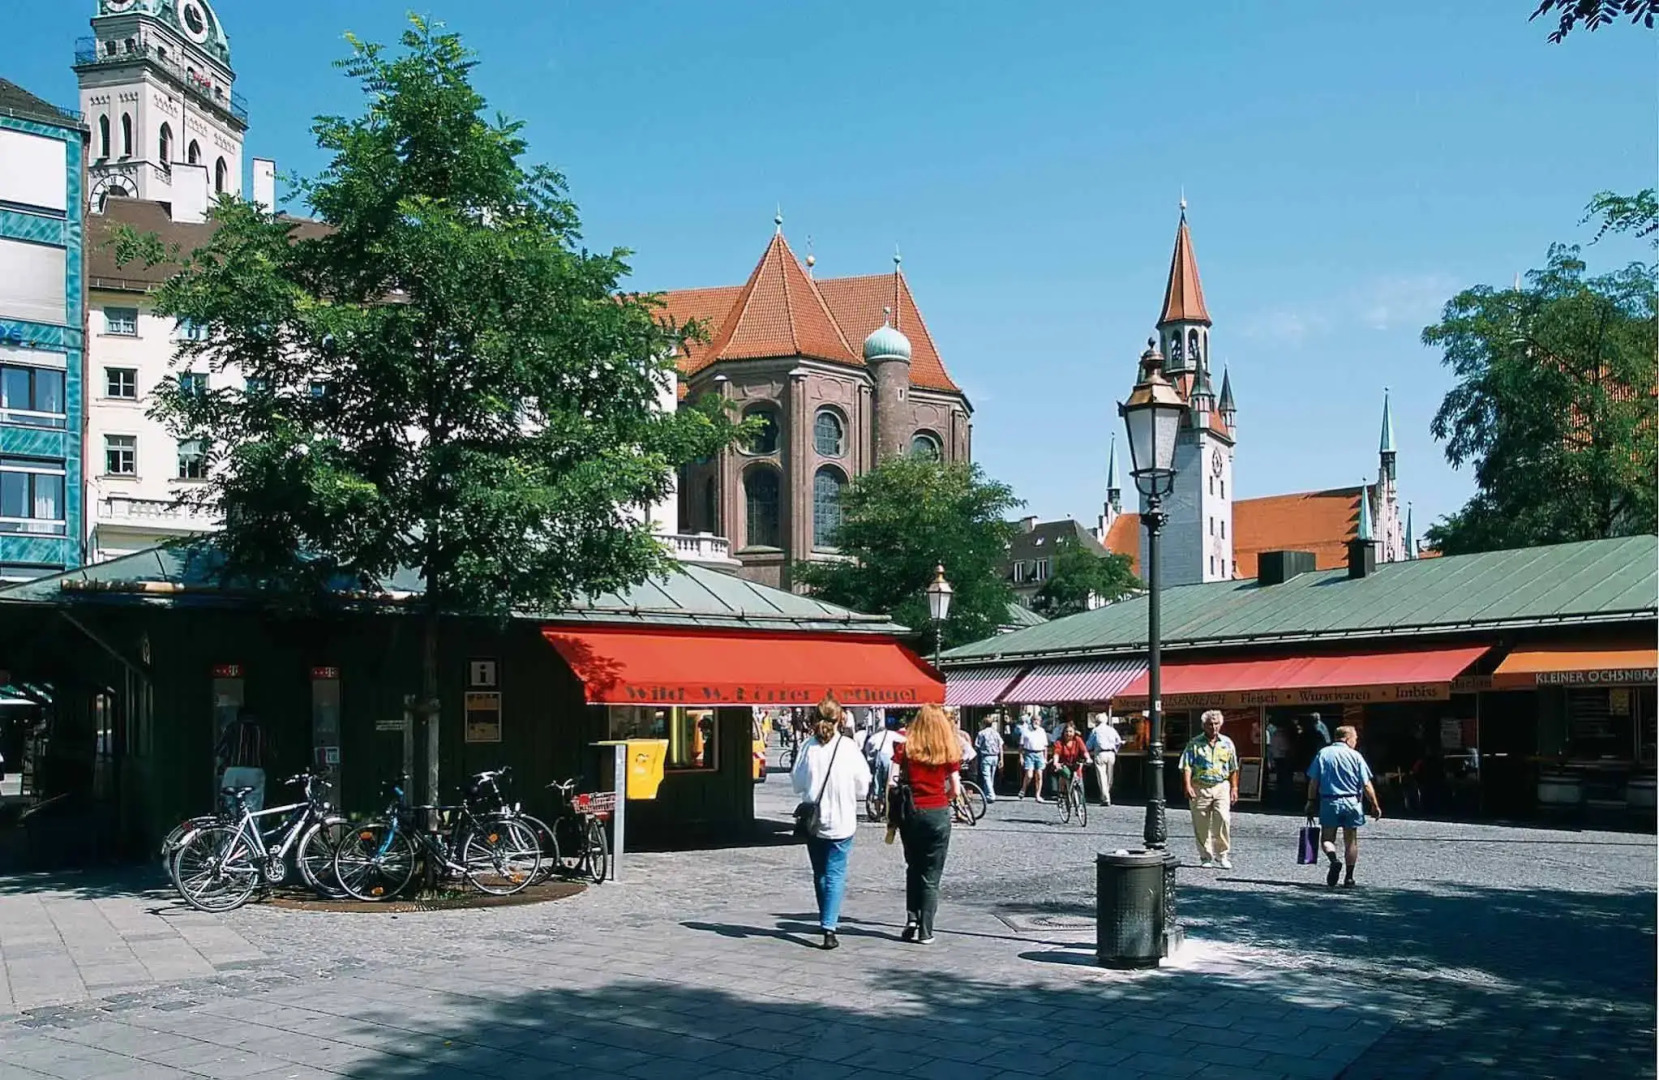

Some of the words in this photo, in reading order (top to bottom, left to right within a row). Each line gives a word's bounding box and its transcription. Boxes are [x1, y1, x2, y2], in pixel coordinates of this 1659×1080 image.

[1535, 672, 1584, 684] KLEINER
[1240, 692, 1278, 704] Fleisch
[1300, 689, 1370, 702] Wurstwaren
[1396, 685, 1438, 699] Imbiss
